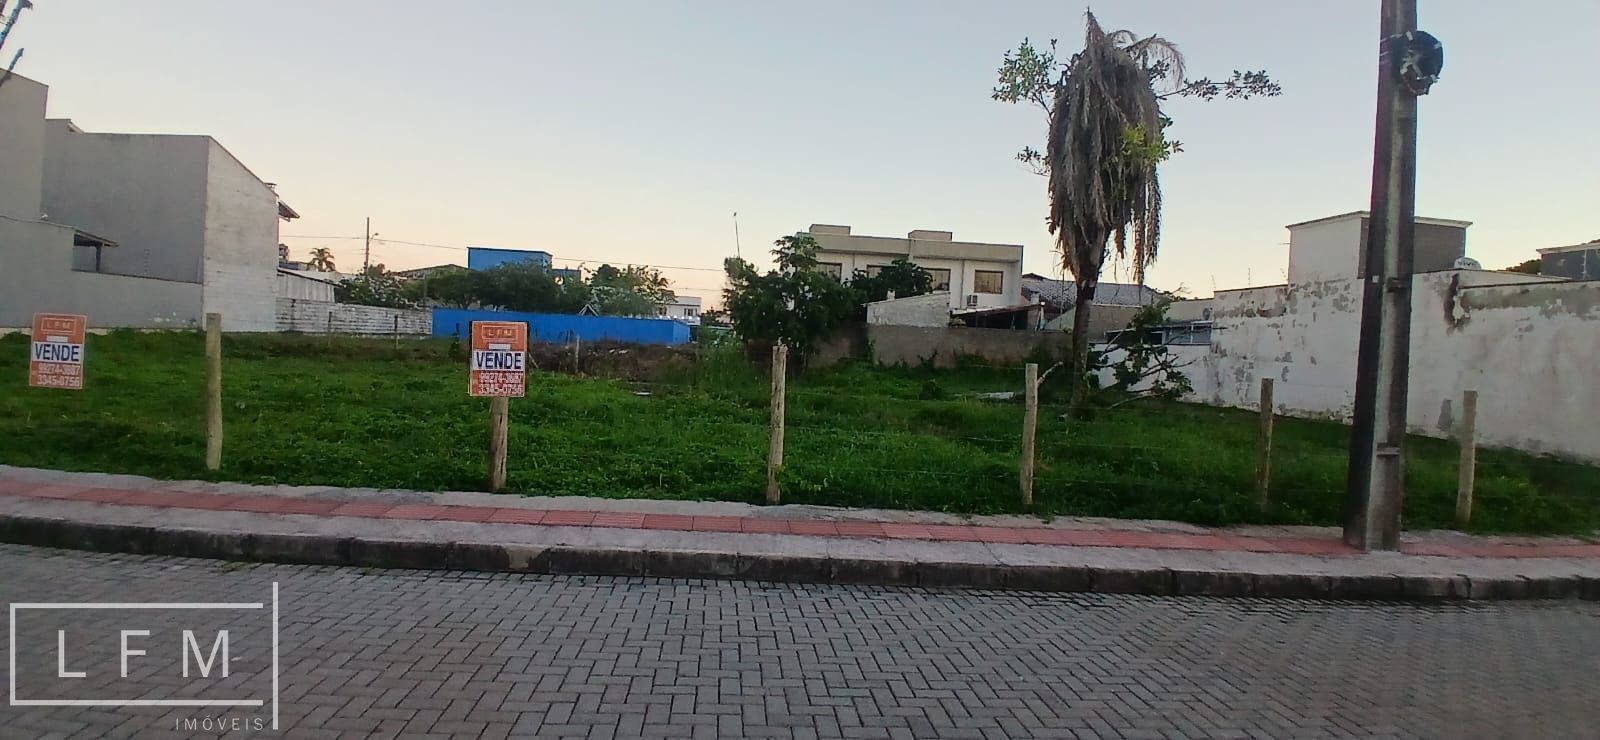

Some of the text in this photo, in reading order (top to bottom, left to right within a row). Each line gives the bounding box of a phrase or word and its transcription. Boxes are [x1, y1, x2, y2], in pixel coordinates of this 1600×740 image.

[35, 343, 80, 362] VENDE
[476, 352, 521, 369] VENDE
[37, 375, 80, 387] 3345-0756
[479, 383, 523, 394] 3345-0756
